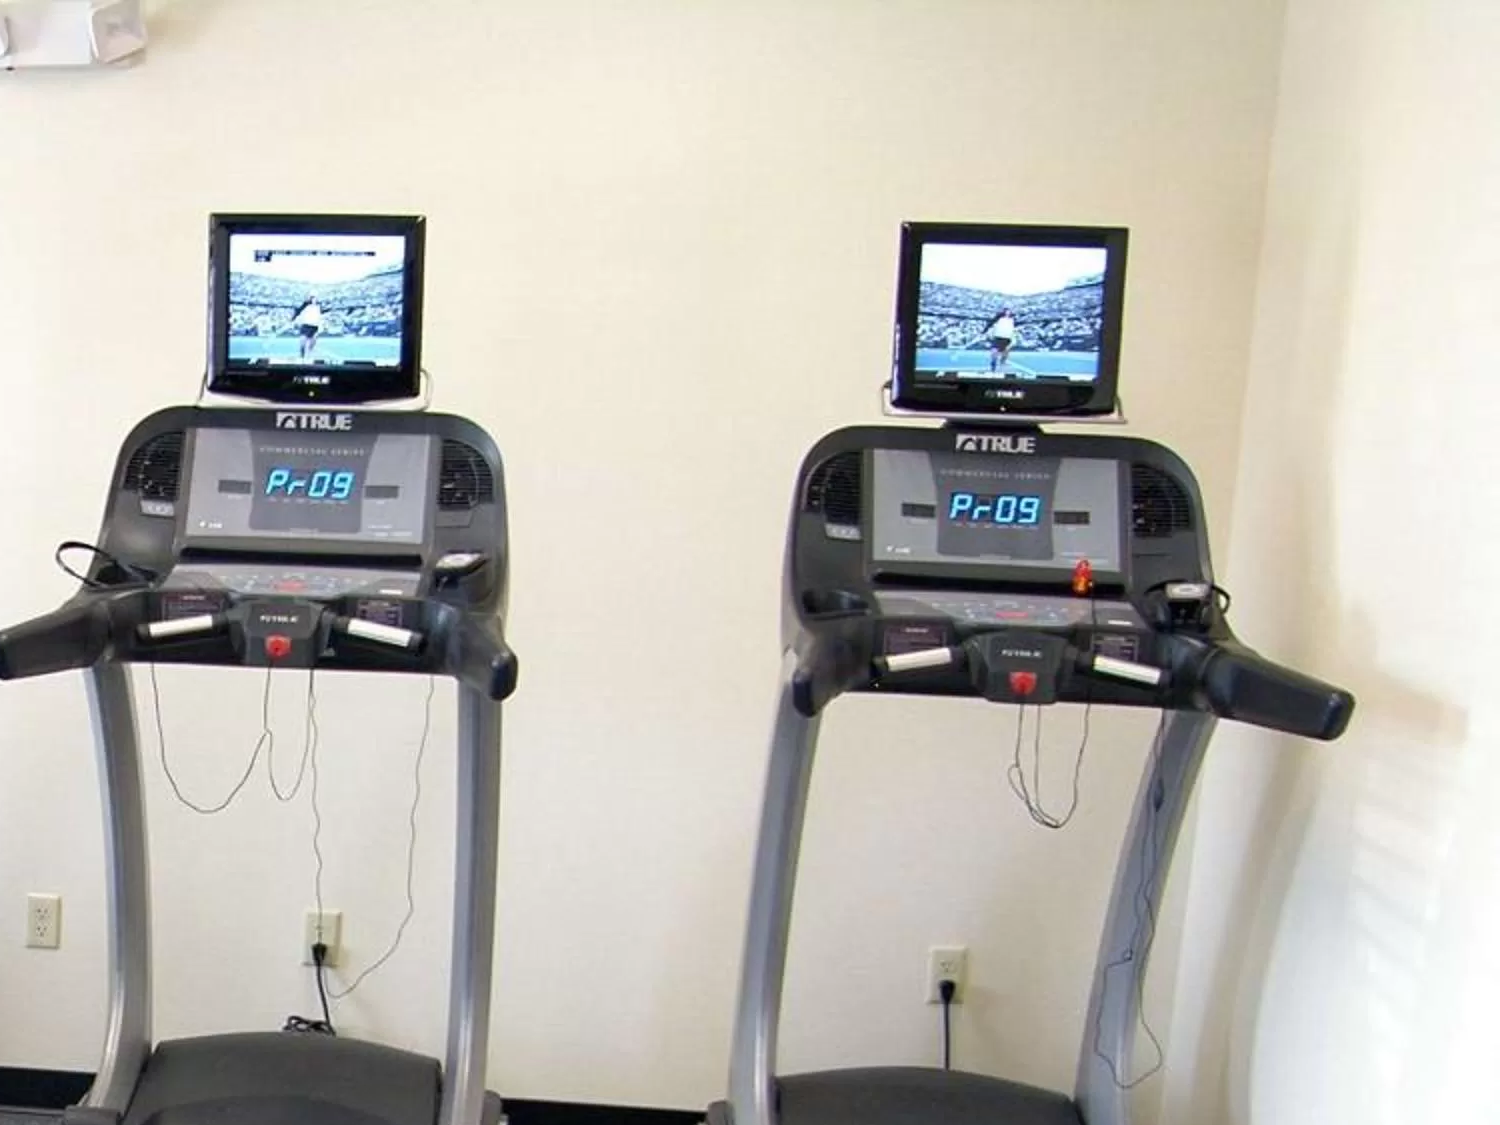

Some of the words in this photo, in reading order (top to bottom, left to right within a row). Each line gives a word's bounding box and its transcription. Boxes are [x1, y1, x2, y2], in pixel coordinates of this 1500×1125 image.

[297, 413, 352, 430] TRUE
[979, 436, 1037, 453] TRUE
[265, 469, 355, 498] Pr09
[949, 494, 1040, 523] Pr09
